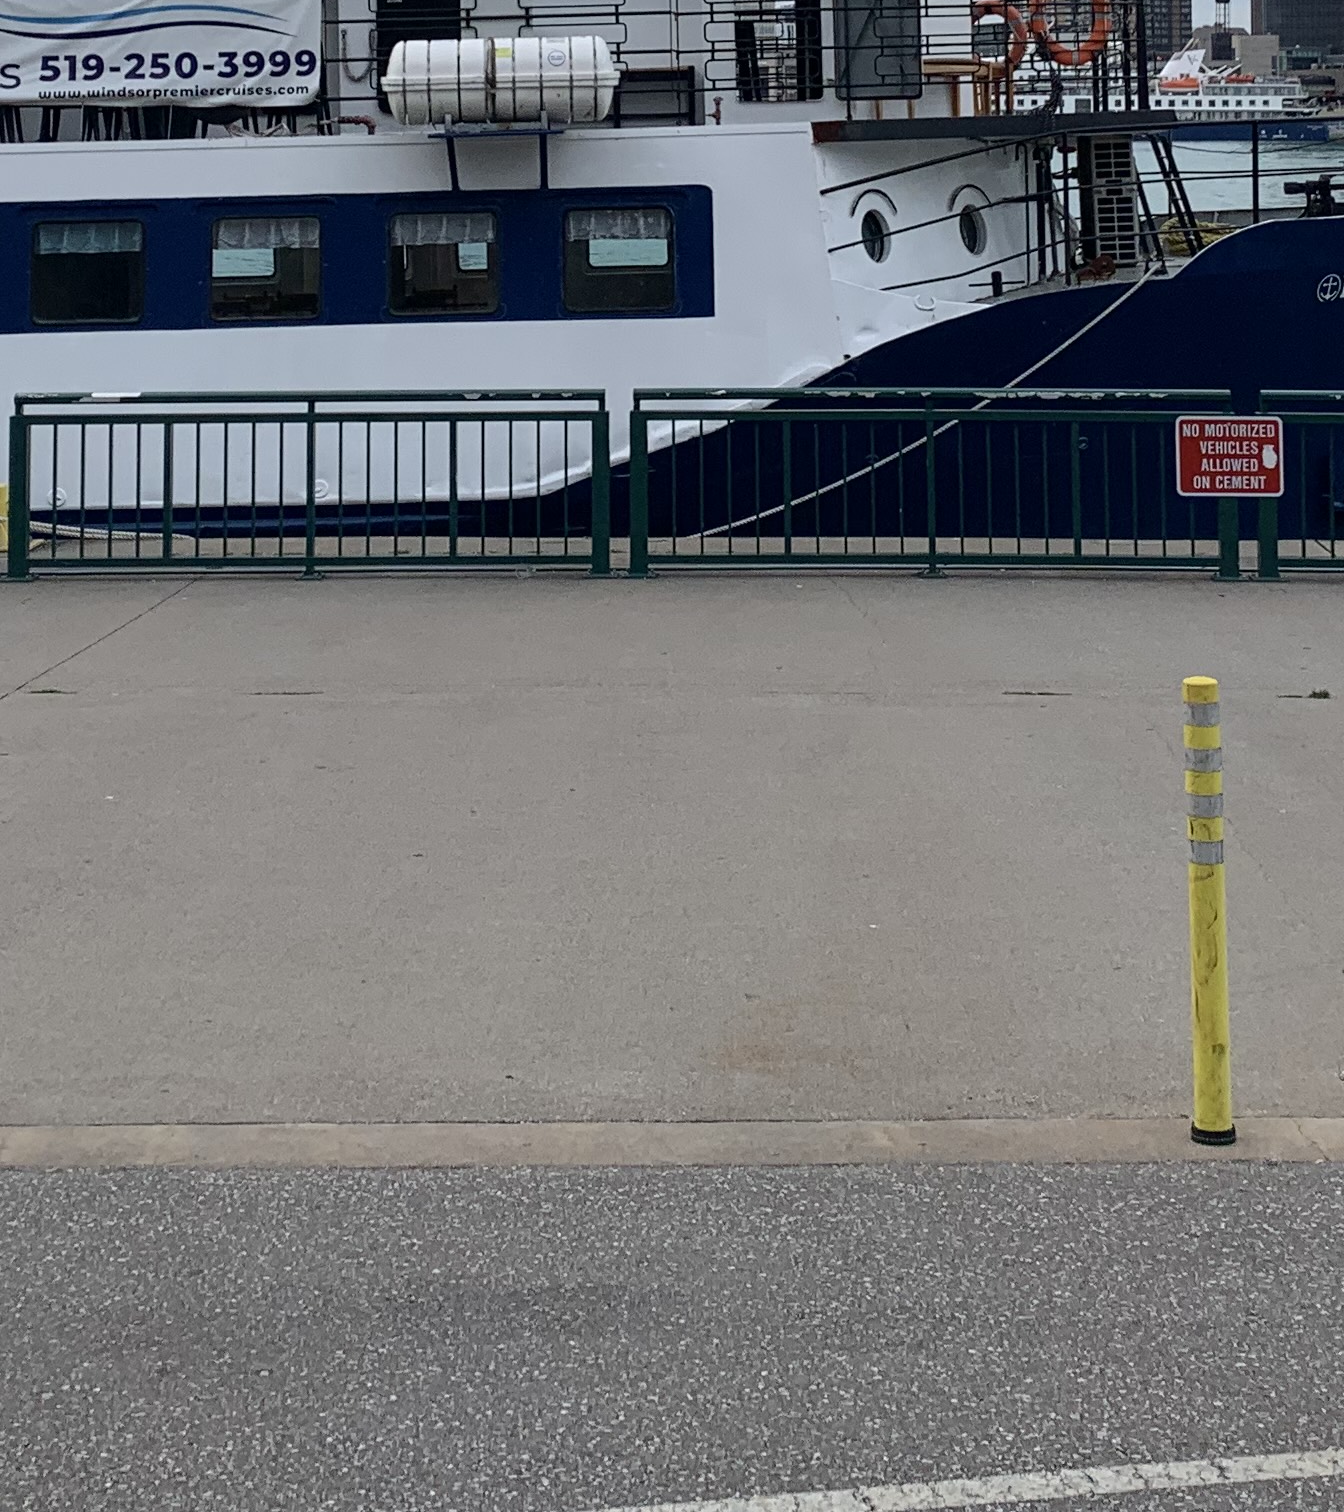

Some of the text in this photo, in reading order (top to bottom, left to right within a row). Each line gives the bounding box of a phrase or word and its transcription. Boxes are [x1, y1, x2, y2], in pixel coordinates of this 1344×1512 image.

[38, 49, 317, 83] 519-250-3999
[38, 84, 309, 101] www.windsorpremiercruises.com
[1182, 423, 1275, 438] NO MOTORIZED
[1199, 440, 1259, 455] VEHICLES
[1201, 458, 1258, 472] ALLOWED
[1193, 475, 1267, 489] ON CEMENT
